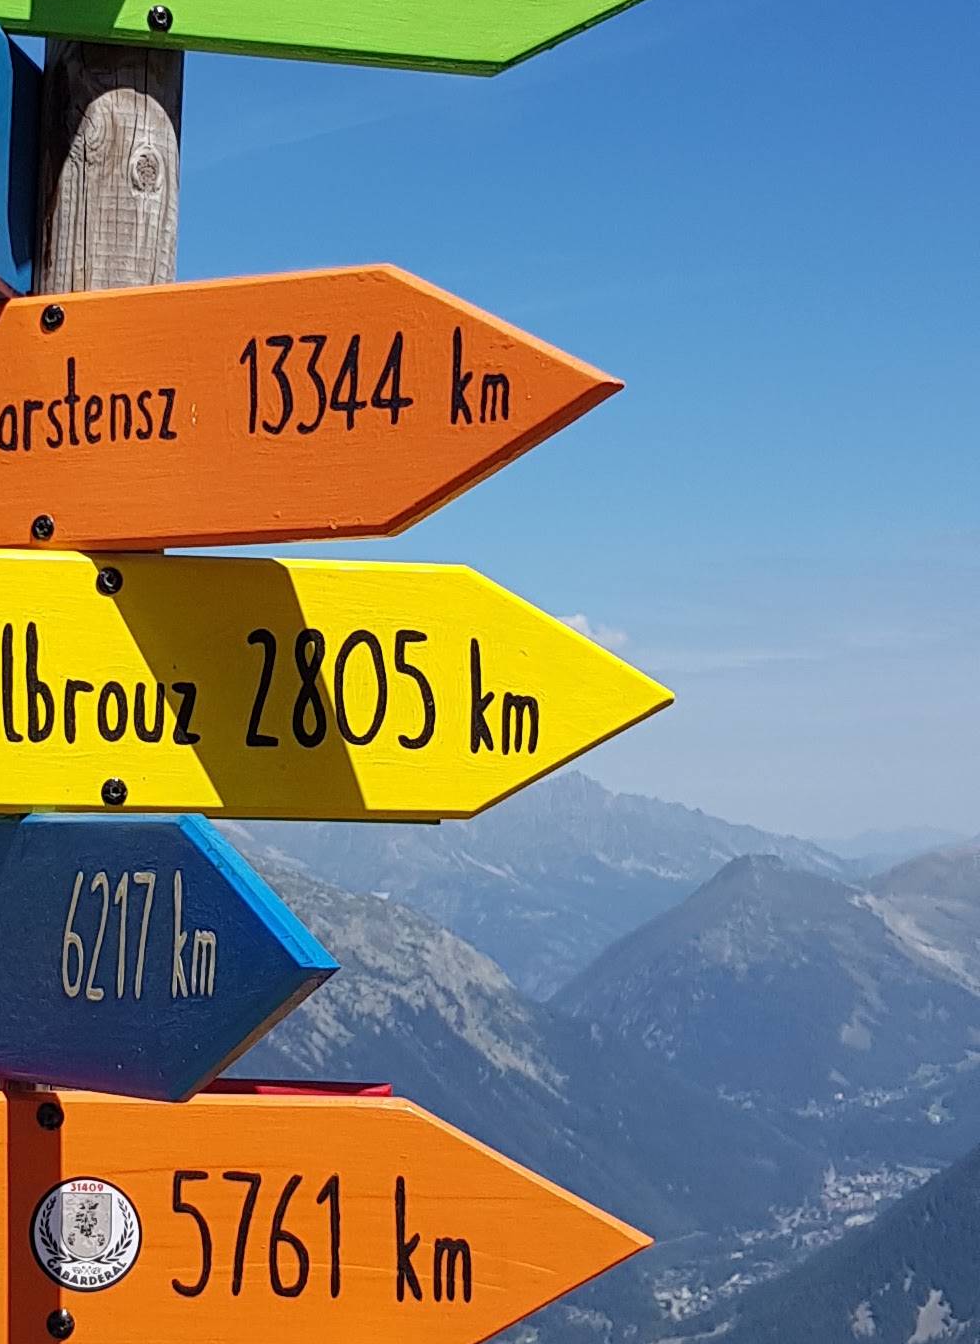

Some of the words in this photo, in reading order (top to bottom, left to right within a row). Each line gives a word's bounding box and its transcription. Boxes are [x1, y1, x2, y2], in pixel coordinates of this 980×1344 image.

[239, 331, 414, 435] 13344
[451, 326, 510, 425] km
[245, 628, 437, 751] 2805
[469, 638, 540, 756] km
[61, 870, 156, 1002] 6217
[171, 868, 218, 999] km
[70, 1183, 104, 1192] 31409
[171, 1171, 342, 1298] 5761
[395, 1177, 472, 1303] km
[46, 1258, 127, 1285] CABARDERAL
